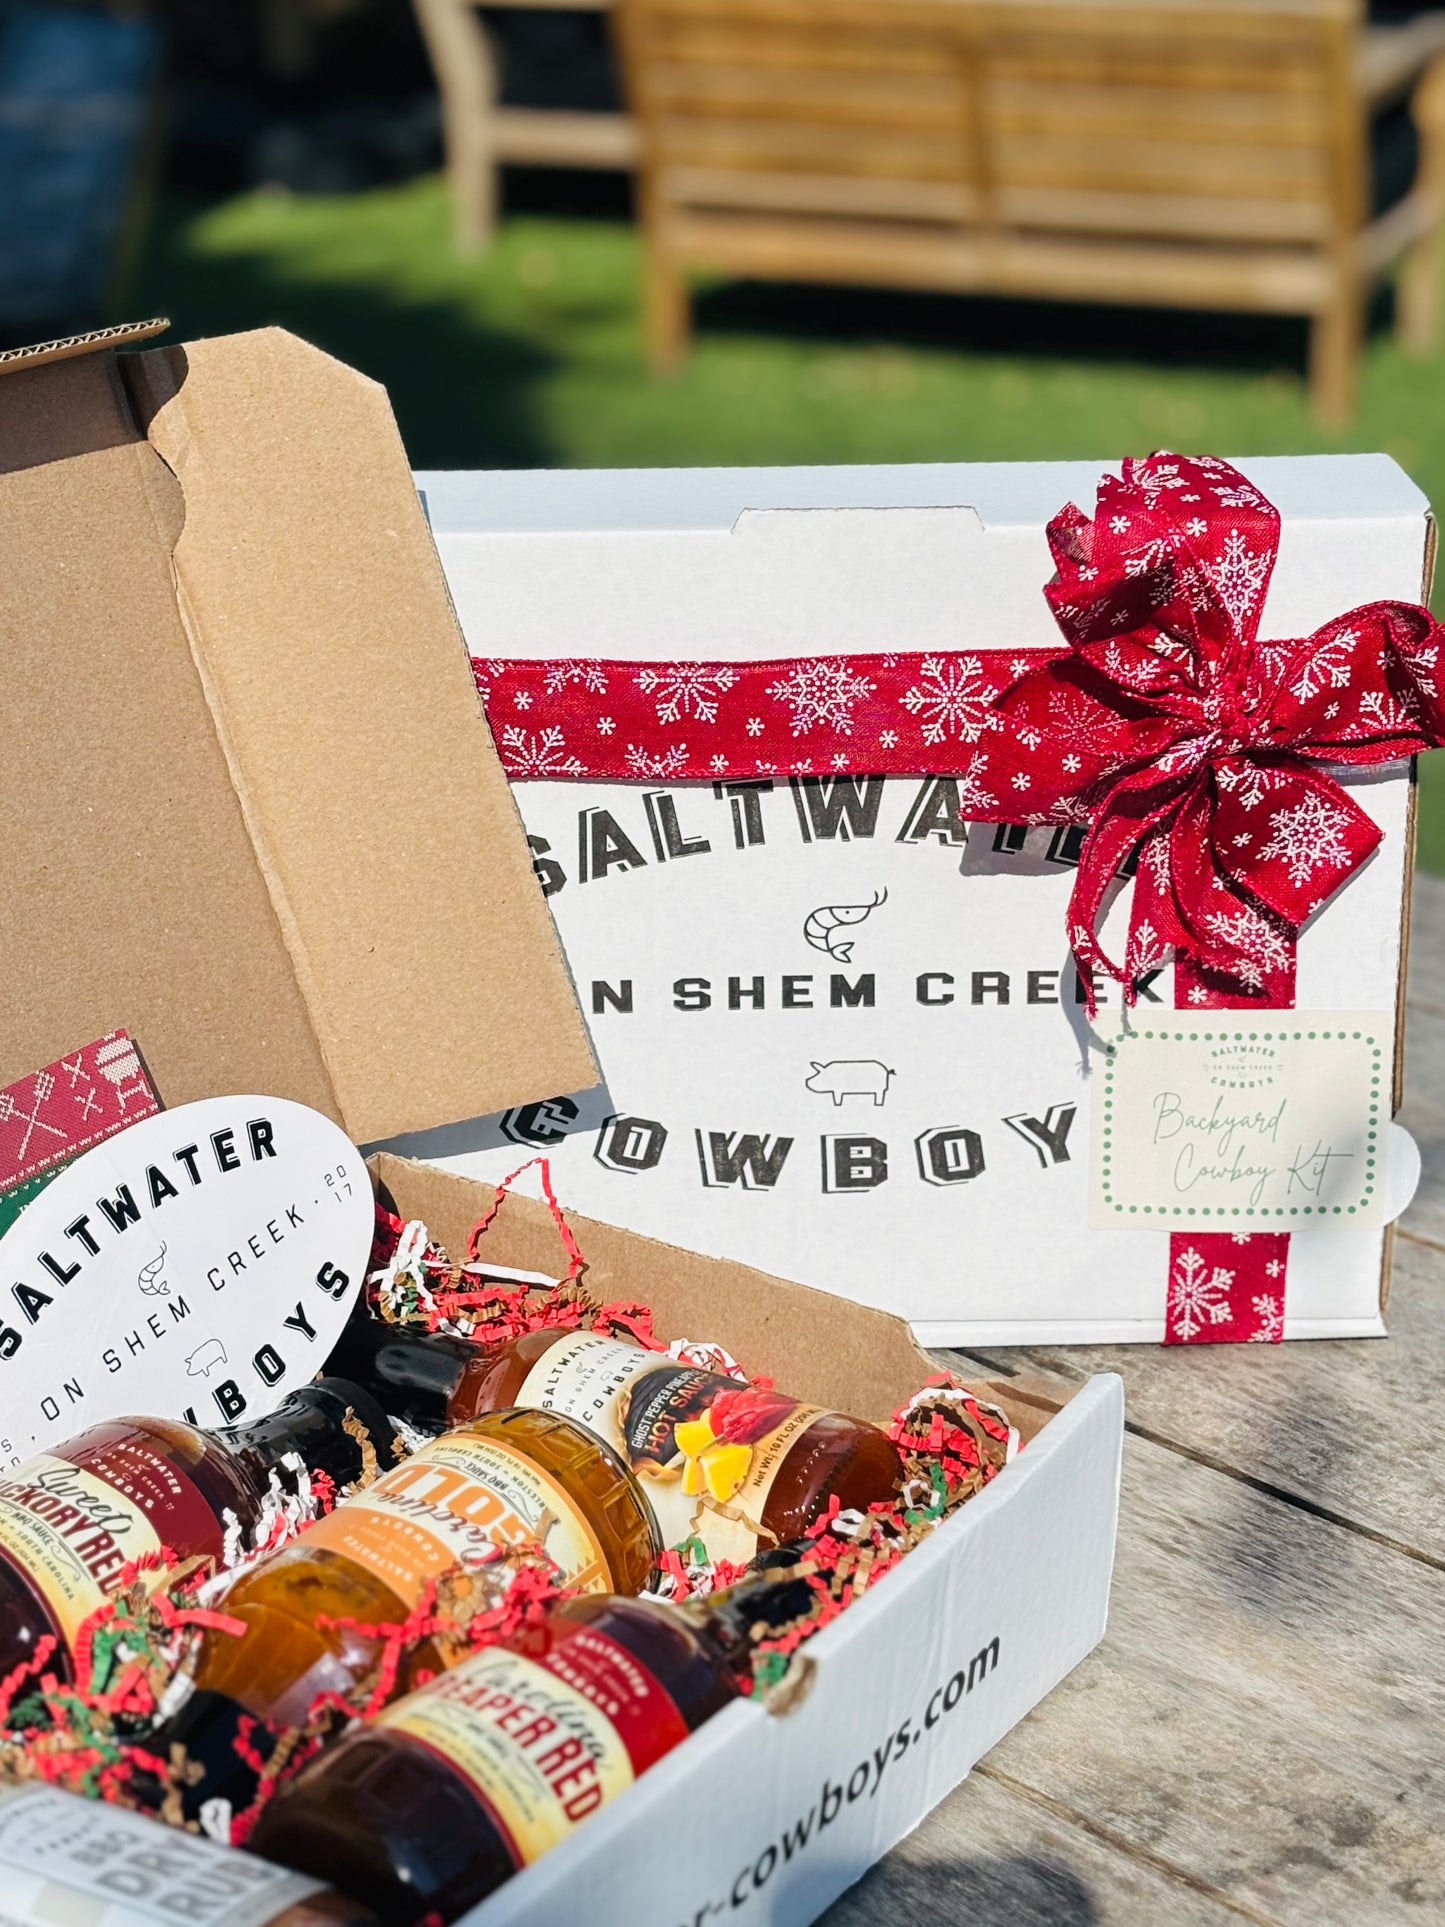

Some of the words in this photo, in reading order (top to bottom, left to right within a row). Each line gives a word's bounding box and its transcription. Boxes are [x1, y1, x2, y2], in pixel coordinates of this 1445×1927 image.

[673, 973, 876, 1012] SHEM
[915, 968, 1164, 1004] CREEK
[1211, 1045, 1275, 1058] SALTWATER
[1210, 1076, 1273, 1088] COWBOYS
[1153, 1091, 1287, 1157] Backyard
[1174, 1142, 1276, 1206] Cowboy
[1286, 1138, 1354, 1196] Kit
[0, 1117, 278, 1361] SALTWATER
[40, 1376, 85, 1421] ON
[102, 1295, 191, 1374] SHEM
[207, 1203, 305, 1292] CREEK
[541, 1339, 607, 1409] SALTWATER
[582, 1352, 646, 1422] COWBOYS
[630, 1417, 653, 1449] GHOST
[644, 1388, 674, 1420] PEPPER
[643, 1409, 677, 1454] HOT
[769, 1441, 782, 1453] 10
[776, 1433, 790, 1444] FL
[784, 1421, 799, 1433] OZ
[90, 1457, 155, 1509] COWBOYS
[117, 1443, 183, 1495] SALTWATER
[464, 1461, 490, 1480] SAUCE
[0, 1480, 97, 1539] ICKORY
[27, 1467, 134, 1534] Sweet
[28, 1522, 56, 1546] SAUCE
[42, 1555, 76, 1601] CAROLINA
[535, 1736, 604, 1824] RED
[678, 1635, 1001, 1927] r-cowboys.com
